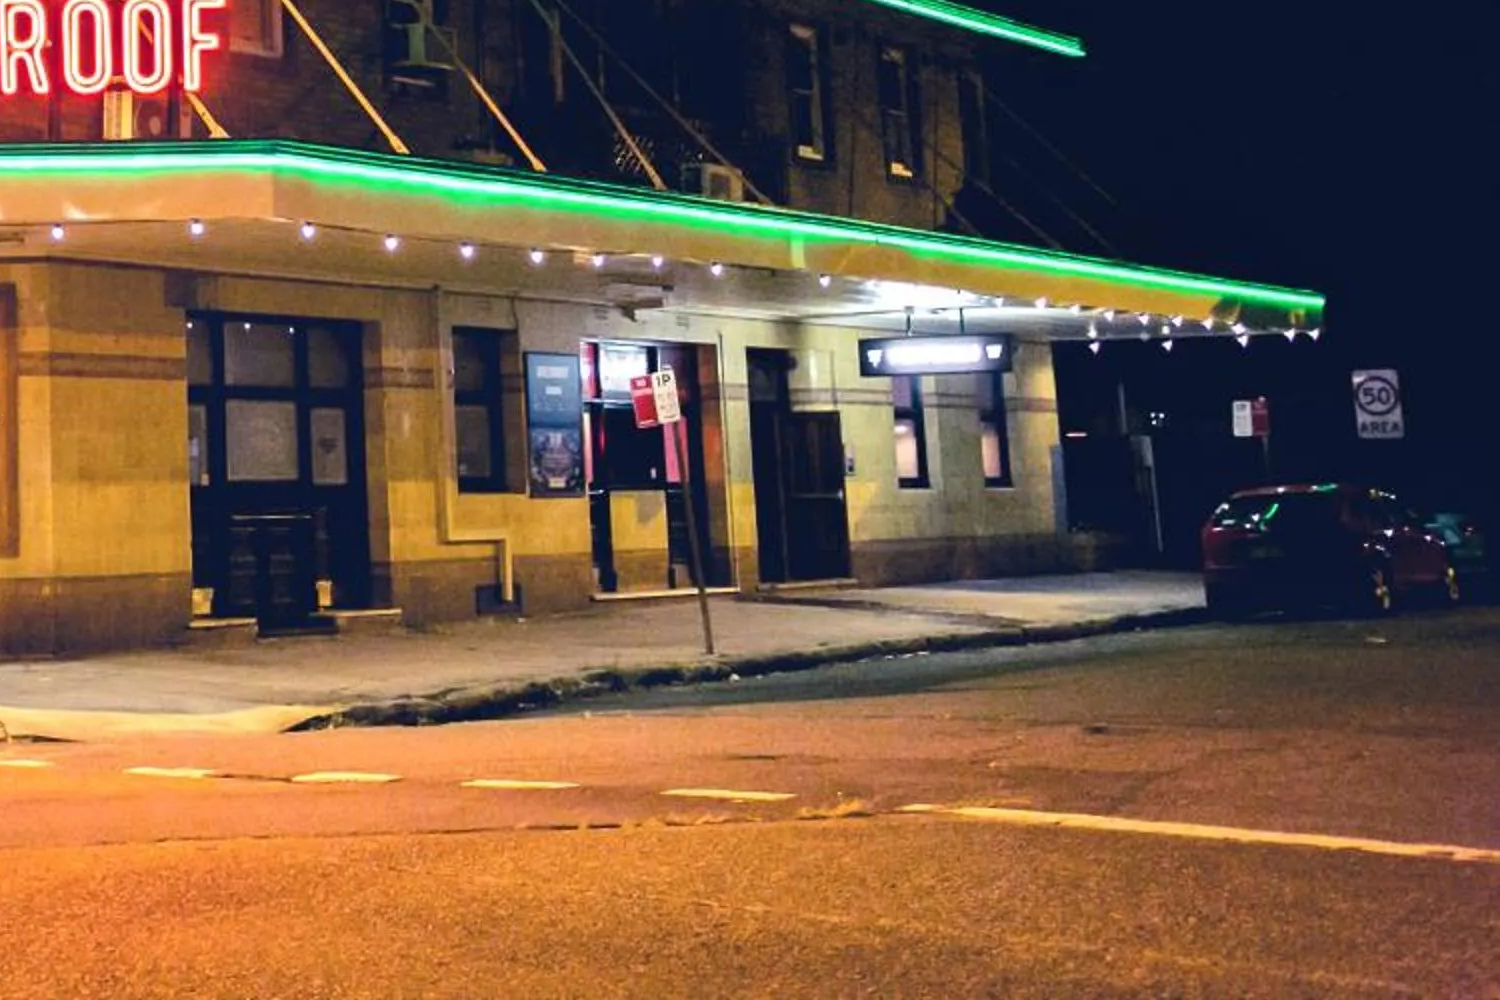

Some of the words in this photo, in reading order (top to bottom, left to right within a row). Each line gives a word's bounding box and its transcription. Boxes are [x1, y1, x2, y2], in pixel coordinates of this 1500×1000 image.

[656, 373, 671, 387] 1P
[1362, 386, 1391, 405] 50
[1359, 420, 1400, 434] AREA
